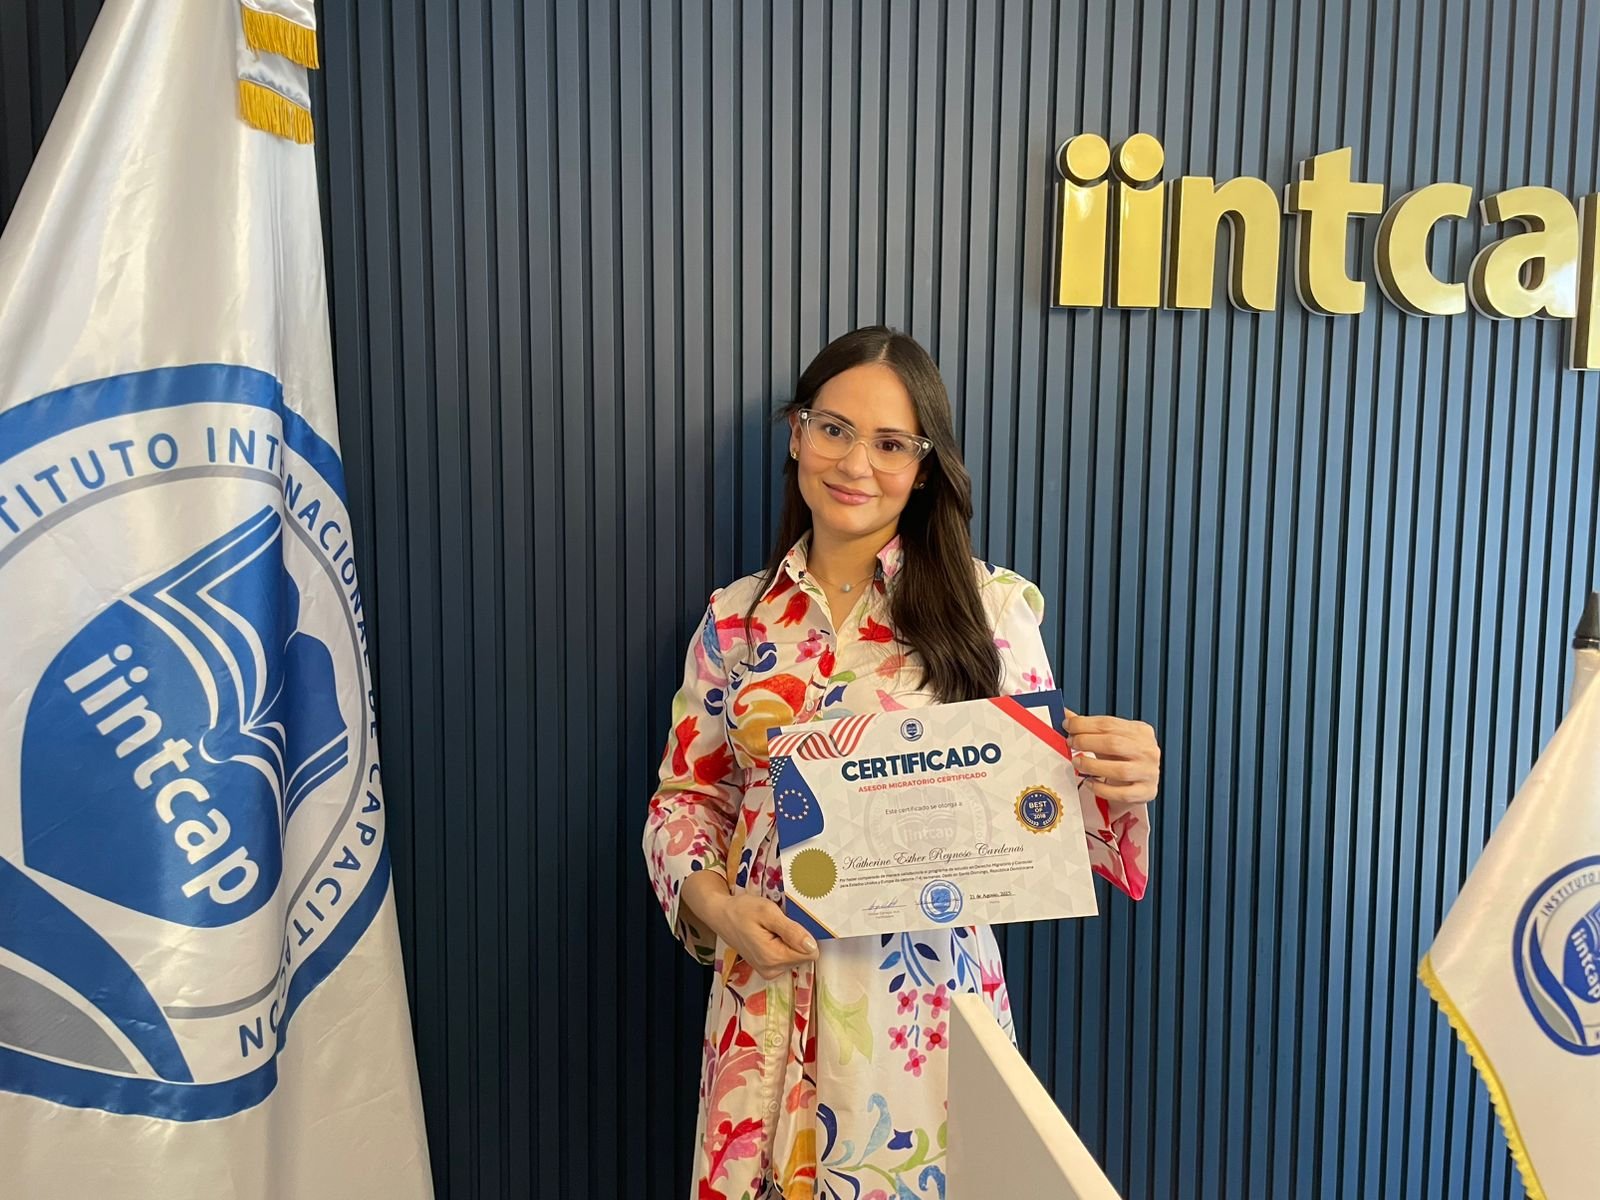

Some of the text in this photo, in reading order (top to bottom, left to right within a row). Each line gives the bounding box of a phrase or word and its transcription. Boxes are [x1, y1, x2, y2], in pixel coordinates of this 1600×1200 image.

[1051, 132, 1600, 370] iintca
[63, 643, 260, 905] iintcap
[841, 743, 1002, 782] CERTIFICADO
[858, 771, 987, 793] ASESOR MIGRATORIO CERTIFICADO
[898, 805, 929, 813] certificado
[937, 801, 957, 809] otorga
[1028, 800, 1047, 809] BEST
[842, 842, 1024, 871] Katherine Esther Reynoso Cardenas
[238, 763, 382, 1058] CAPACITACON
[1540, 872, 1595, 916] INSTITUTO
